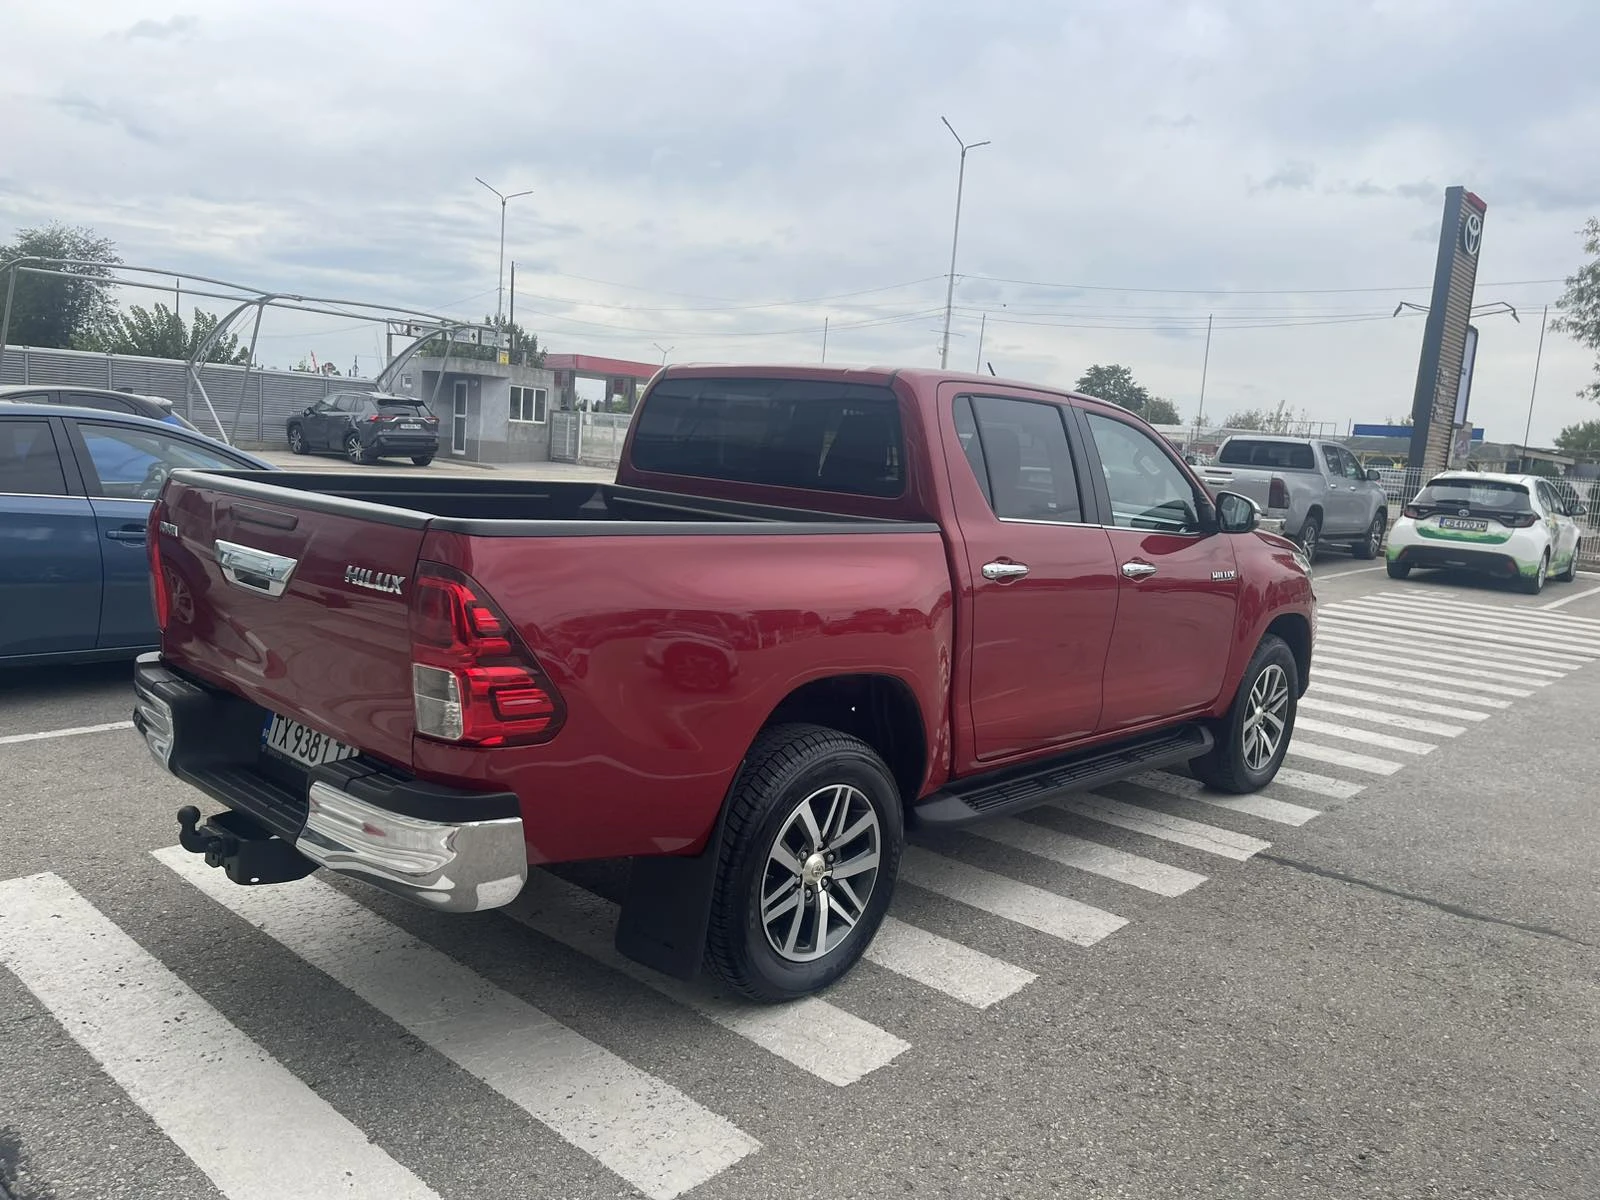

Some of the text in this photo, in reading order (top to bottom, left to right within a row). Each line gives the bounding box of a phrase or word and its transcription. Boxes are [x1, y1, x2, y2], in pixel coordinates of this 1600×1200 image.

[344, 565, 406, 595] HILUX
[273, 713, 294, 749] TX
[292, 725, 331, 764] 9381
